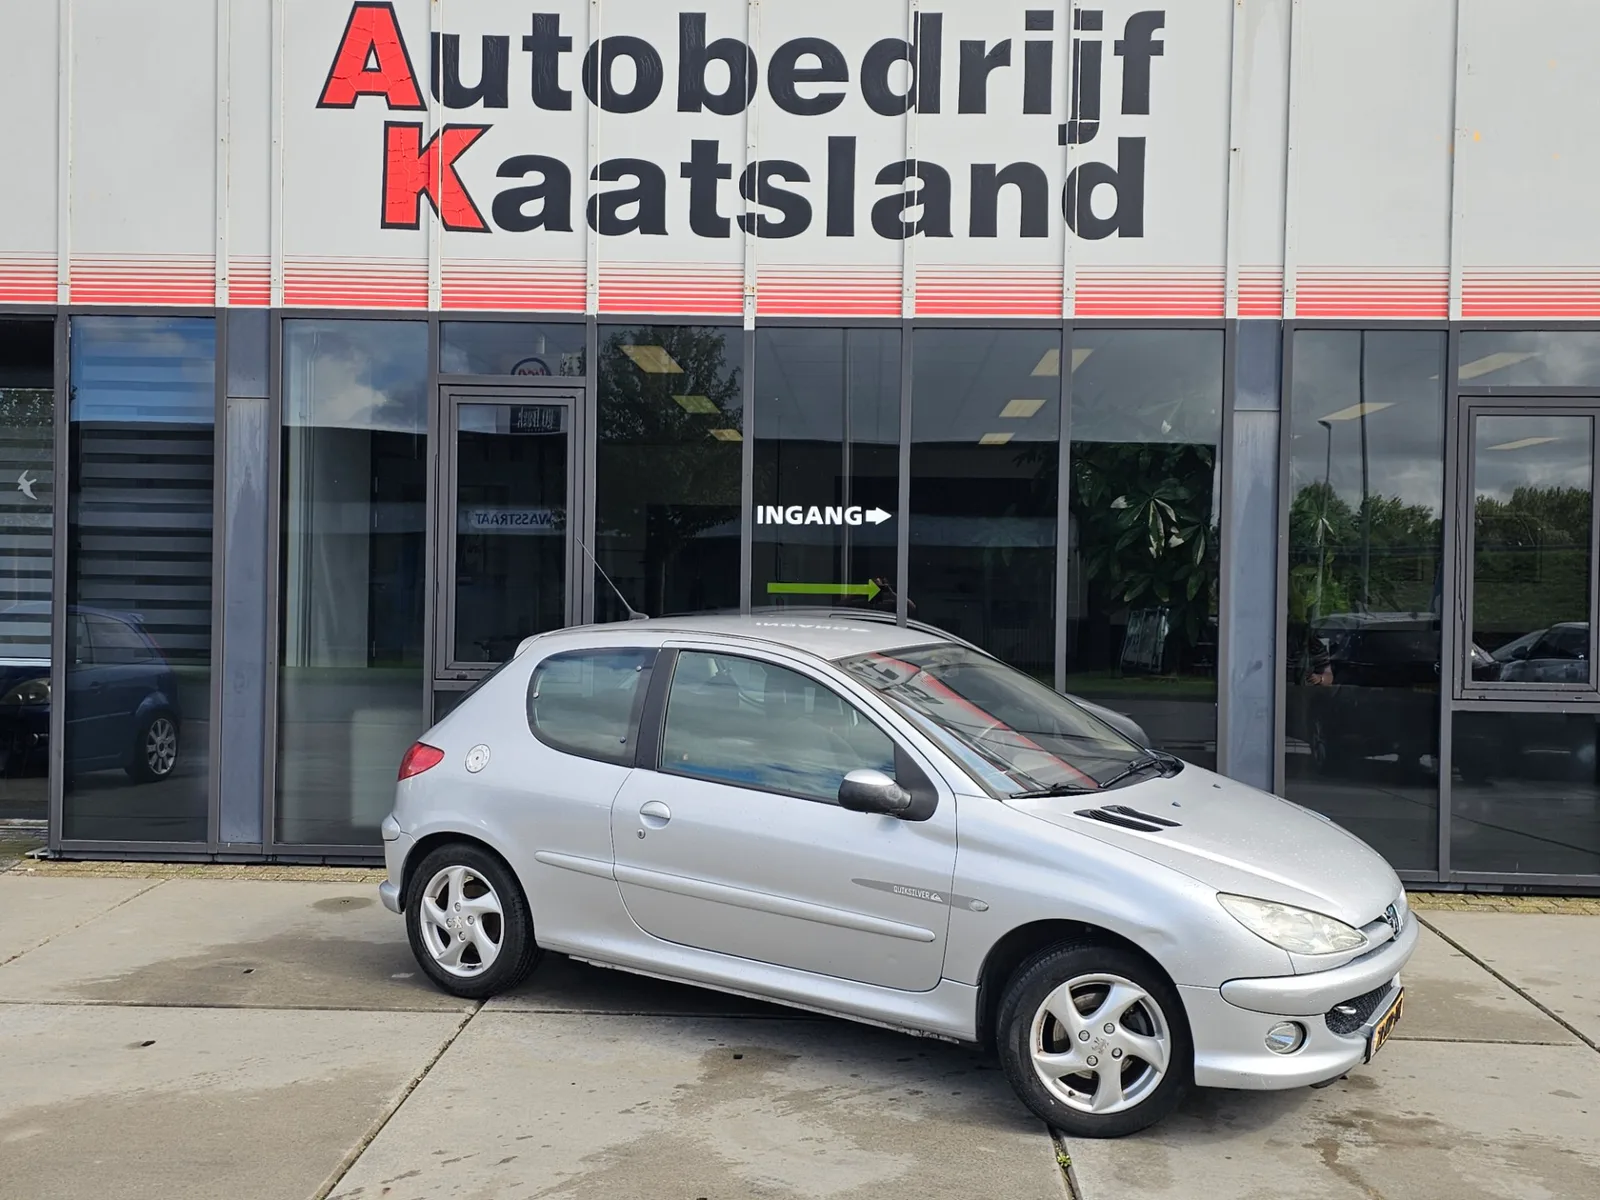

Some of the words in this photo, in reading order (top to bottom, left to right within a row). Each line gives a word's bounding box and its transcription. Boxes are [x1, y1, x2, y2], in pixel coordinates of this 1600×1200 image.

[315, 1, 1165, 145] Autobedrijf
[381, 121, 1146, 238] Kaatsland
[757, 505, 863, 526] INGANG
[893, 885, 930, 900] QUIKSILVER
